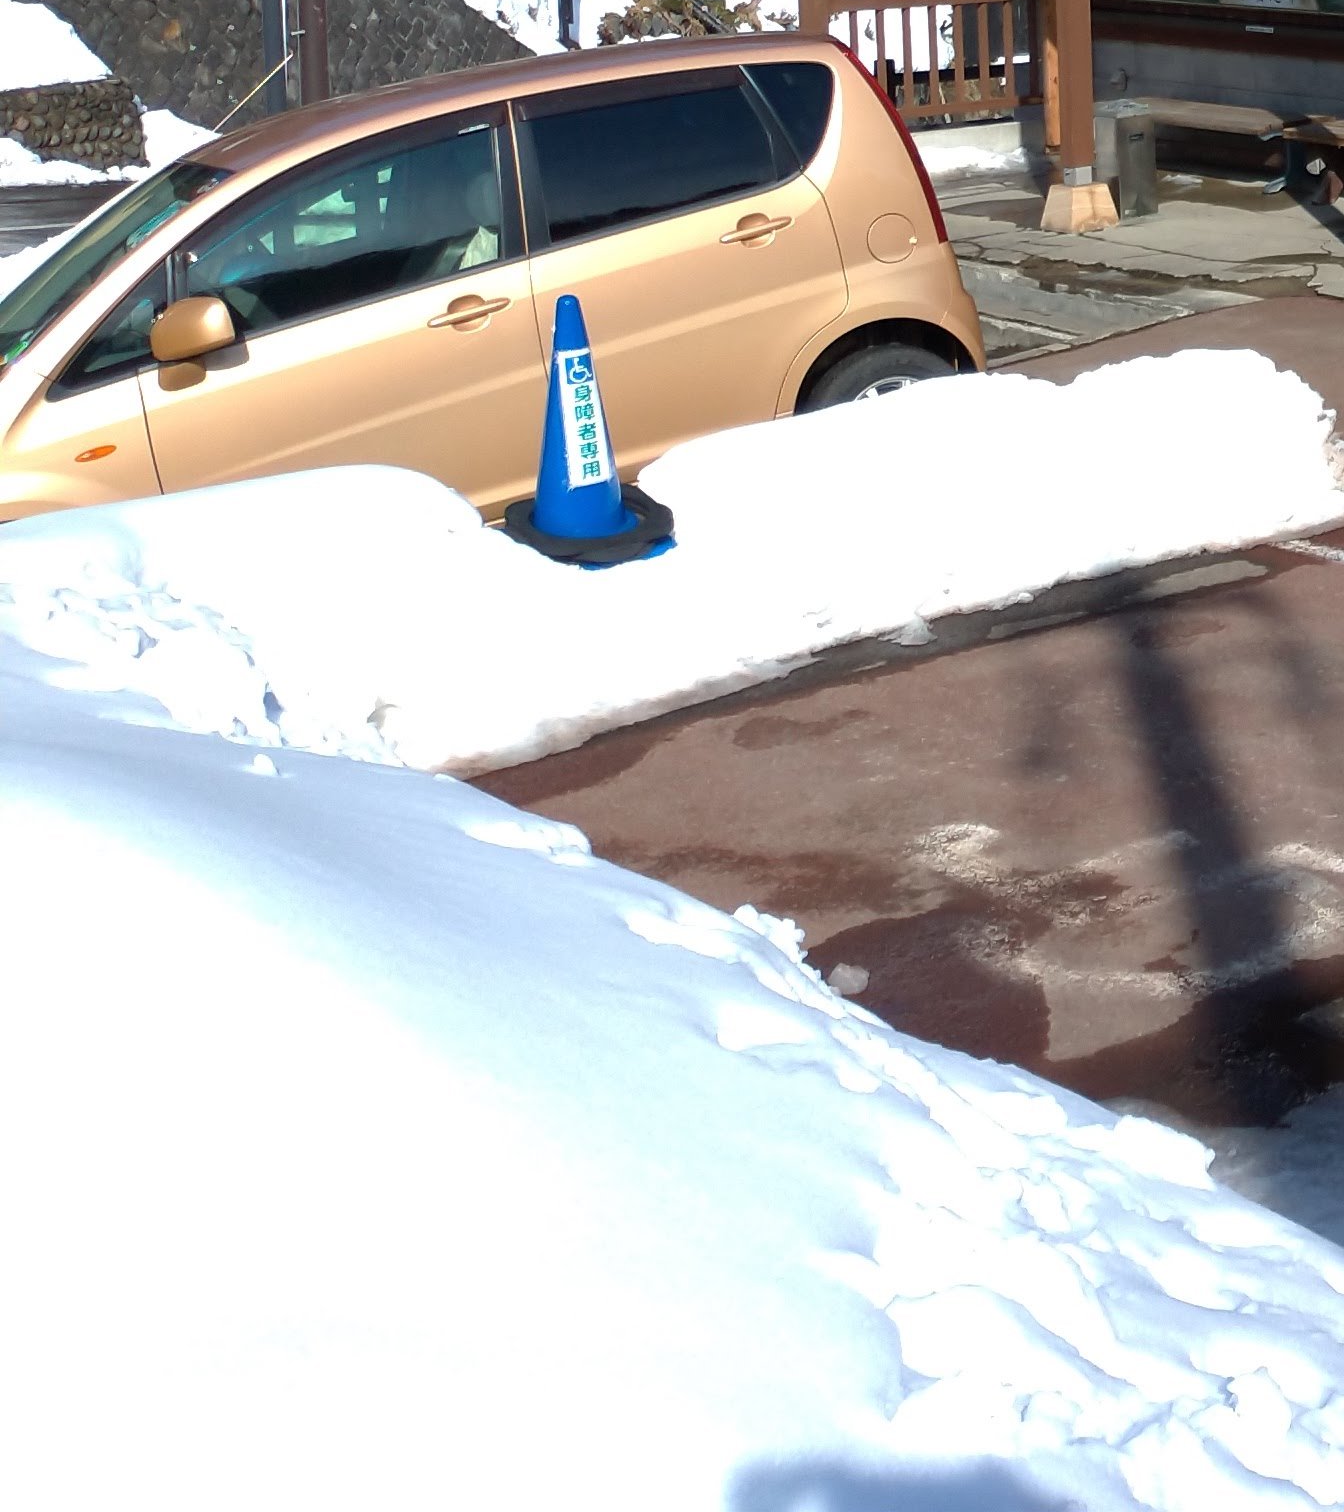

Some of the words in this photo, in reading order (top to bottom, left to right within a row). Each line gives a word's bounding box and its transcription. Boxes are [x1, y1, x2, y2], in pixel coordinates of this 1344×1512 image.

[574, 385, 601, 479] 身障者専用
